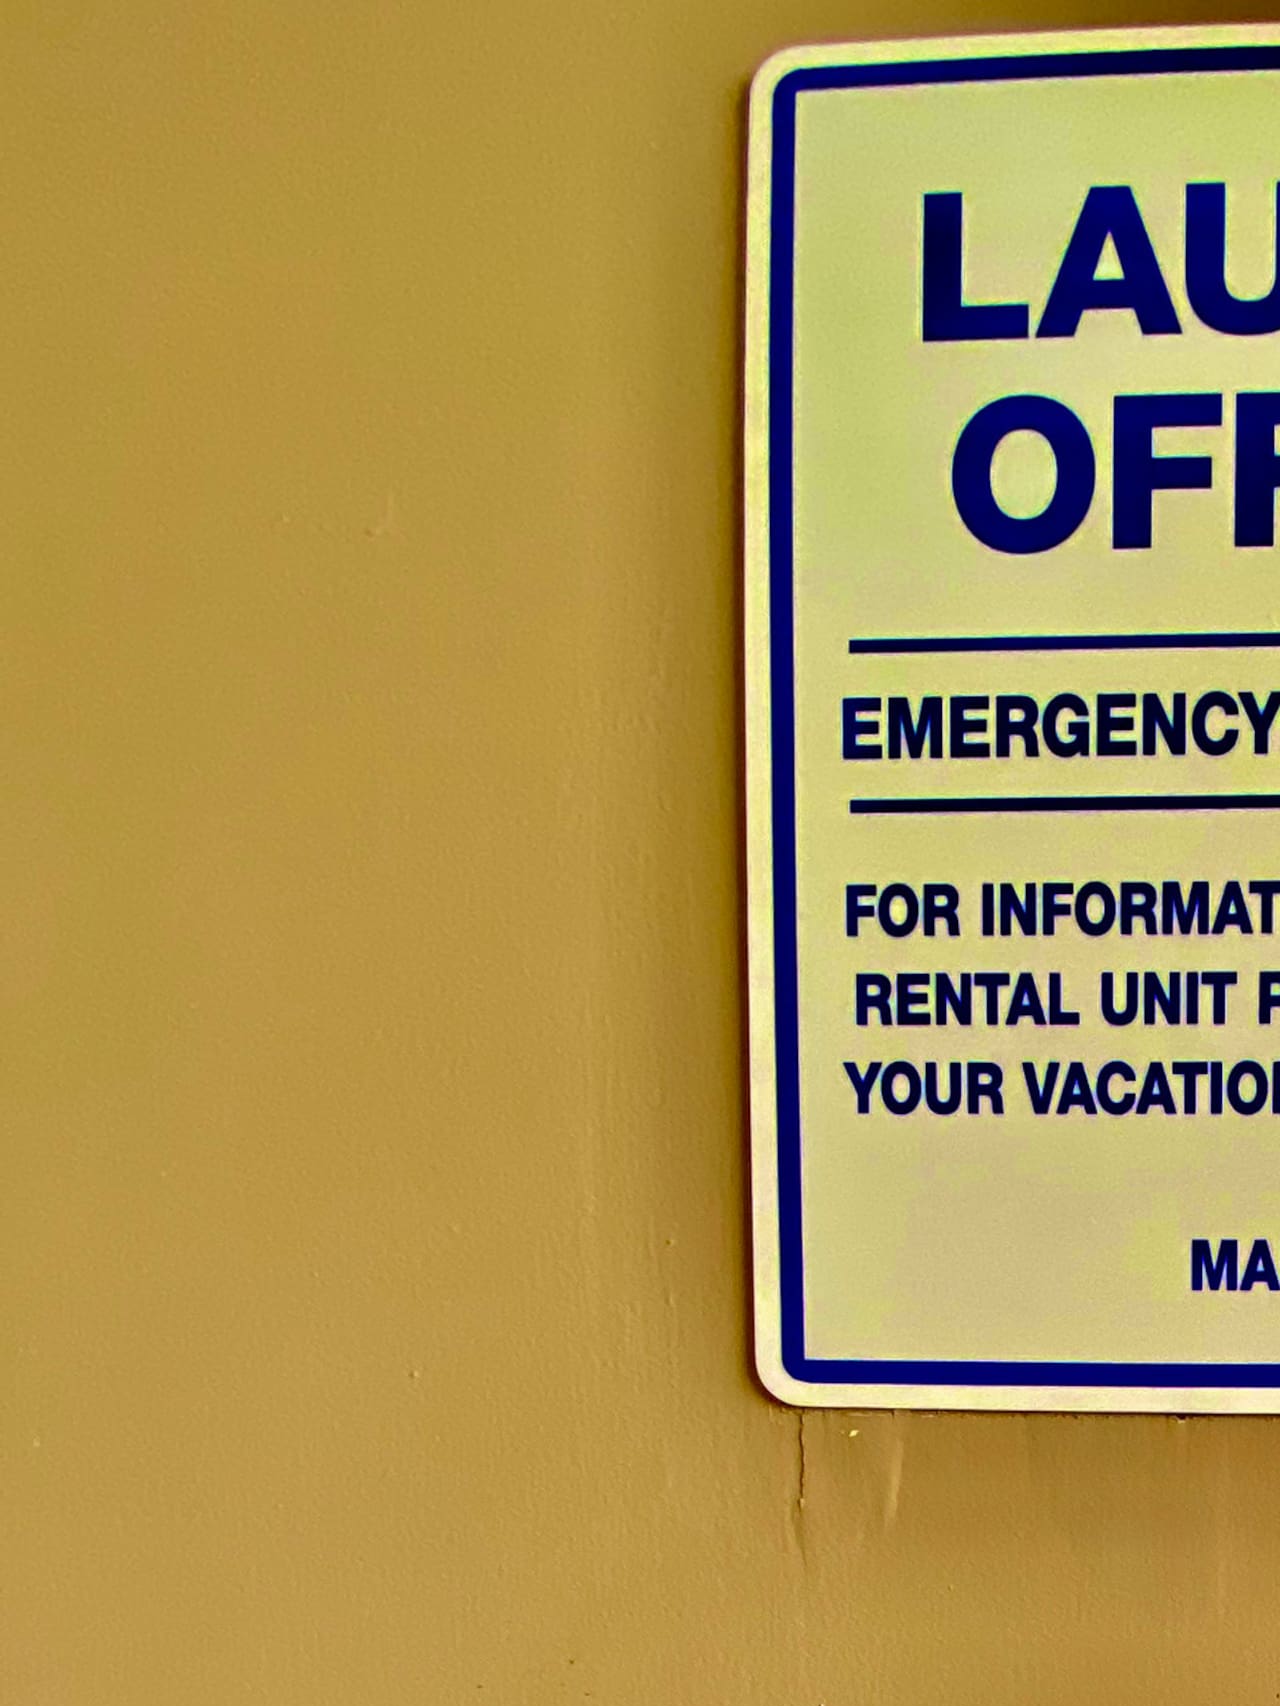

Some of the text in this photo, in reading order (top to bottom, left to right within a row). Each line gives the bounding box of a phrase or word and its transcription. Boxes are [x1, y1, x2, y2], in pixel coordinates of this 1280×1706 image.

[846, 883, 960, 939] FOR
[856, 972, 1080, 1026] RENTAL
[1101, 971, 1238, 1027] UNIT
[842, 1061, 1004, 1116] YOUR
